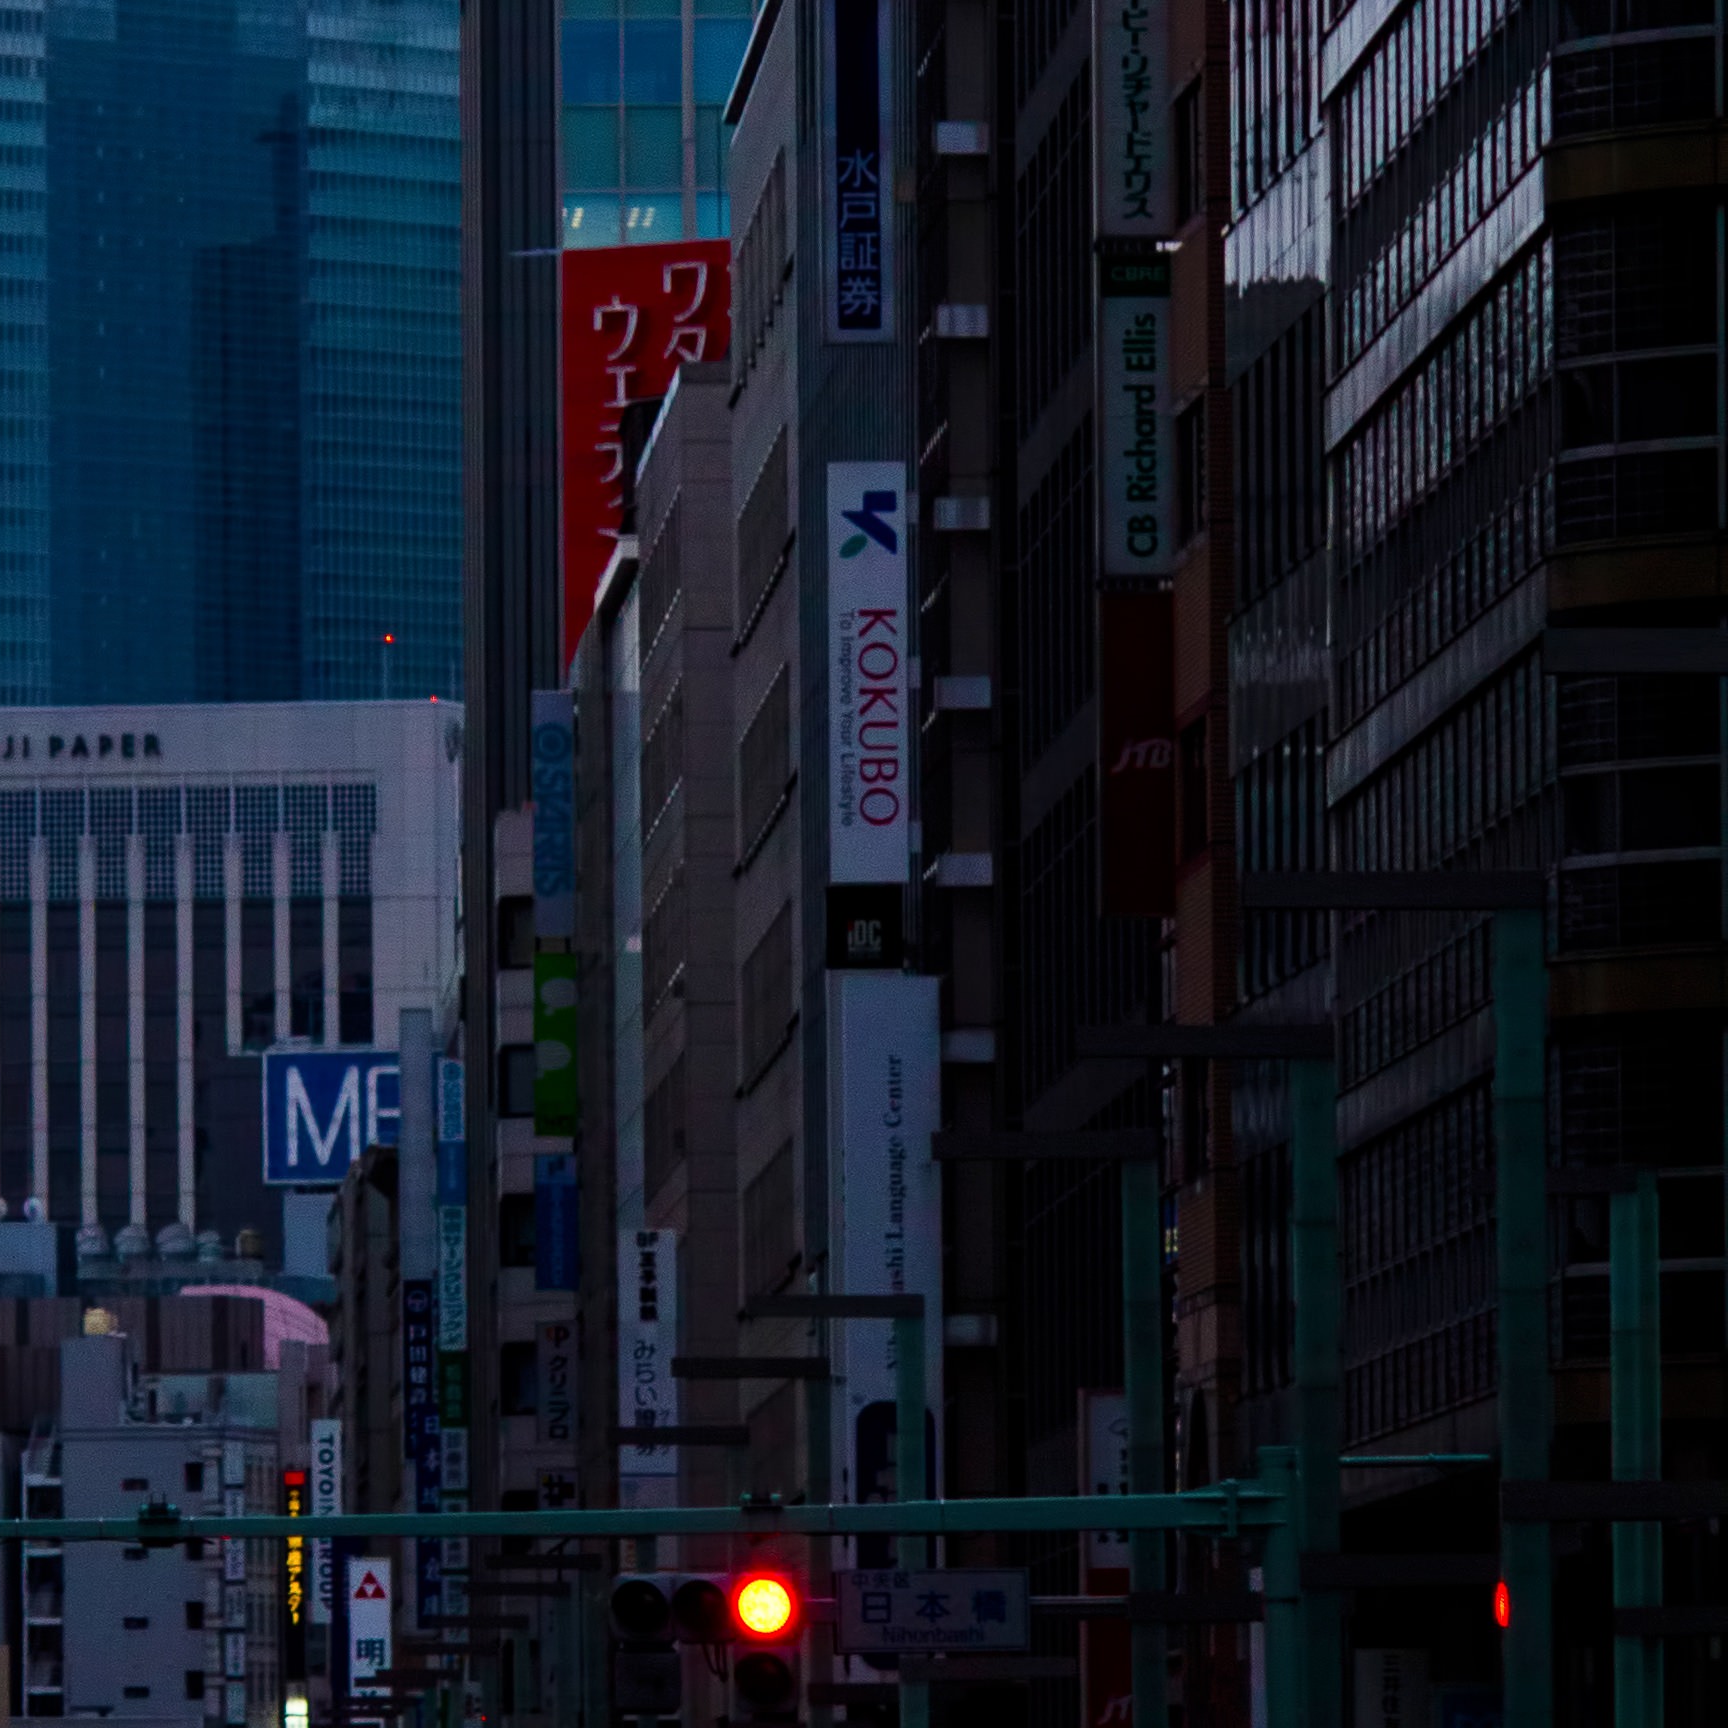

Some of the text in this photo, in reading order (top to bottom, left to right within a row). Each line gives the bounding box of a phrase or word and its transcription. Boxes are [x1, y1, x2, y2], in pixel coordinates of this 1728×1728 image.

[838, 149, 880, 317] 水戸証券
[1122, 313, 1158, 557] CB Richard Ellis
[858, 609, 899, 826] KOKUBO
[49, 733, 161, 759] PAPER
[1112, 736, 1171, 772] JTB
[863, 1591, 1006, 1623] 日本橋
[883, 1627, 984, 1644] Nihonbashi
